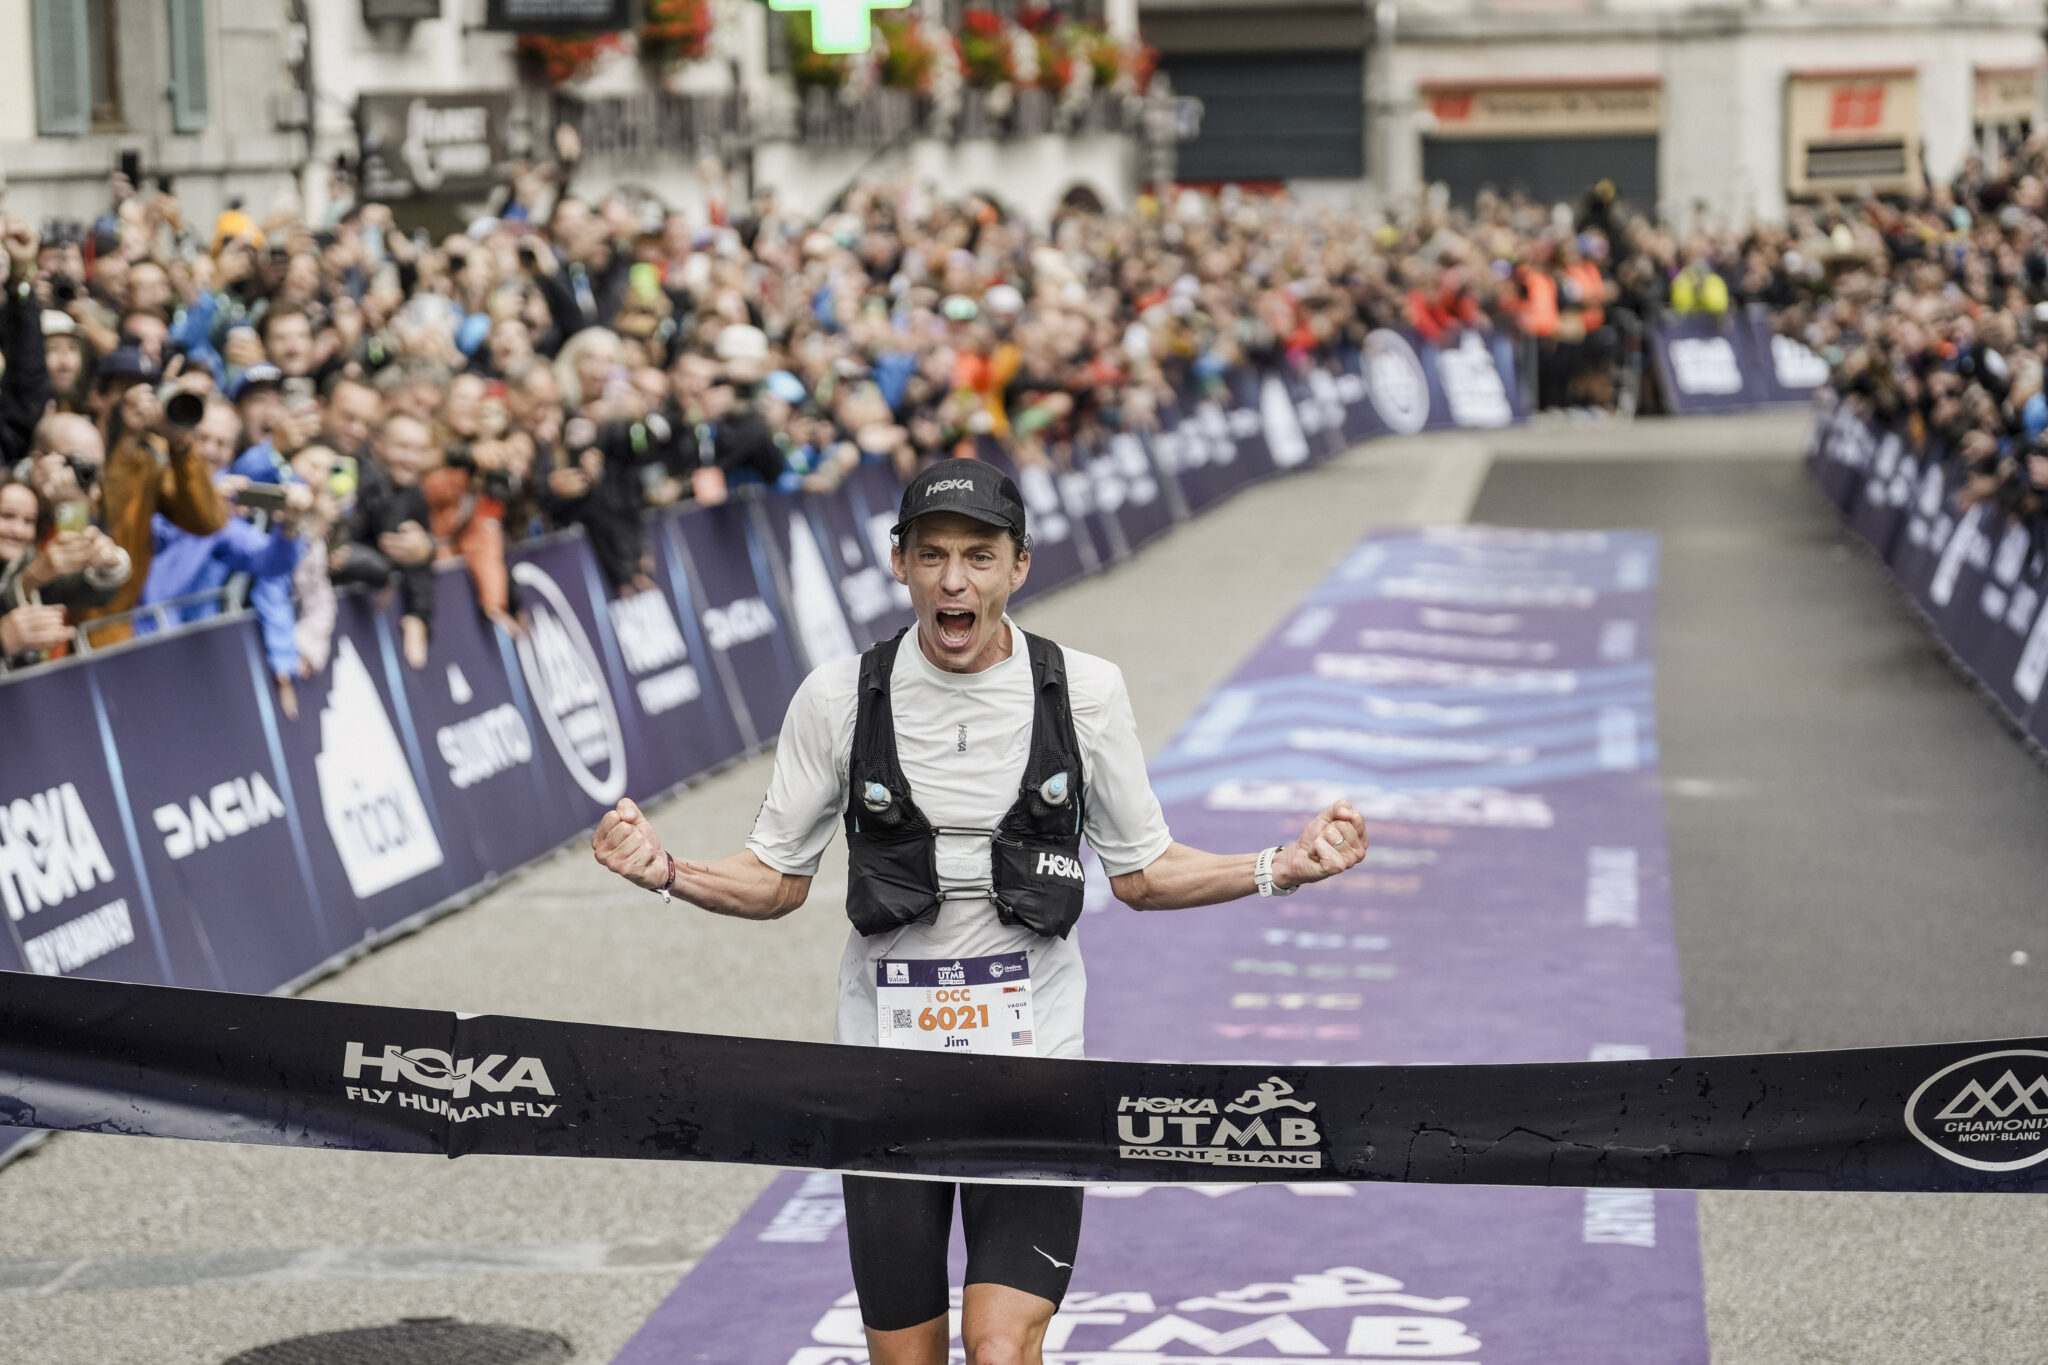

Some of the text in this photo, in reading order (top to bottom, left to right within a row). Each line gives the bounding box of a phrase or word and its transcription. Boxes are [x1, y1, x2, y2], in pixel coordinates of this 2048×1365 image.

[925, 479, 974, 497] HOKA
[958, 724, 968, 752] HOKA
[152, 771, 286, 860] DACIA
[1036, 852, 1085, 882] HOKA
[938, 971, 965, 980] UTMB
[935, 988, 971, 1002] OCC
[918, 1004, 989, 1031] 6021
[1014, 1009, 1020, 1019] 1
[944, 1036, 969, 1047] Jim
[343, 1041, 555, 1098] HOKA
[346, 1086, 558, 1123] FLY HUMAN FLY
[1117, 1096, 1218, 1114] HOKA
[1117, 1115, 1321, 1147] UTMB
[1958, 1131, 2041, 1142] MONT-BLANC
